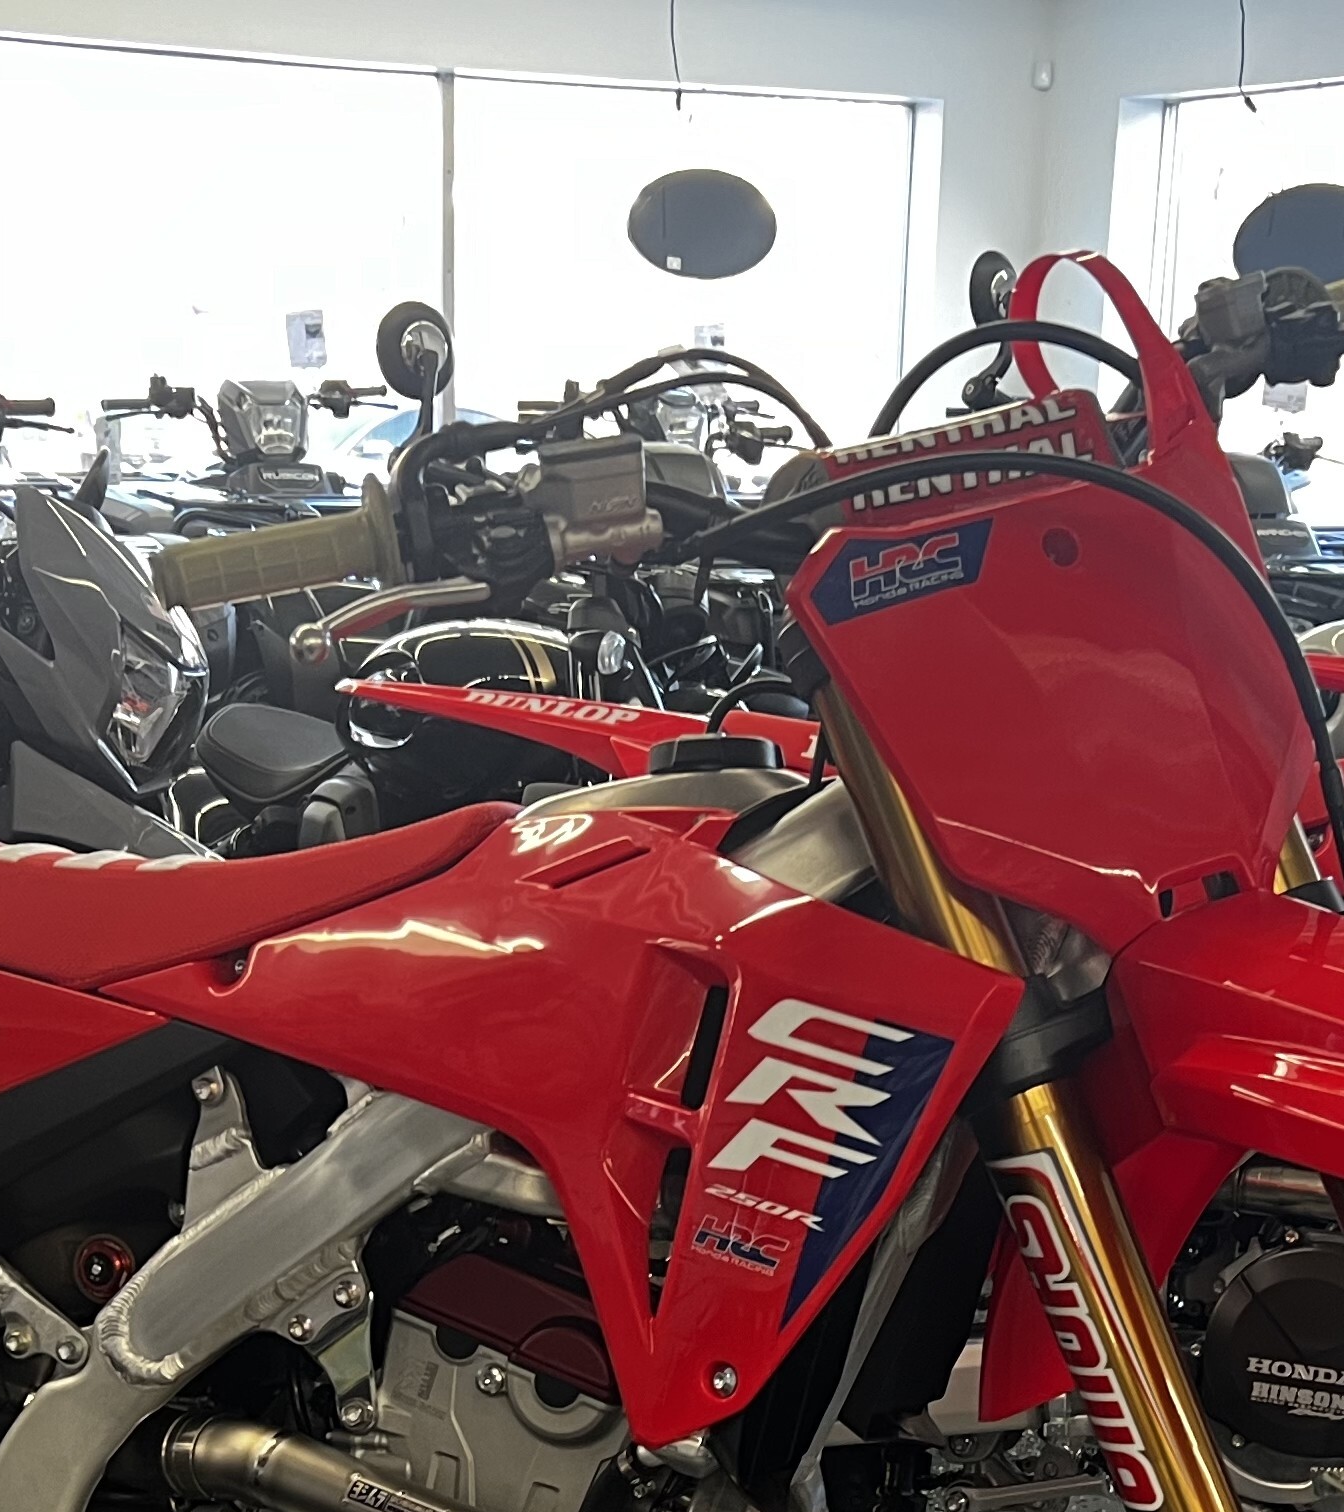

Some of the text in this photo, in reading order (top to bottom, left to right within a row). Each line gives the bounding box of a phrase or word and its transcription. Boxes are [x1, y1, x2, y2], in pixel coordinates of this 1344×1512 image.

[849, 532, 963, 602] HRC
[464, 690, 641, 726] DUNLOP
[706, 998, 917, 1180] CRF
[705, 1183, 826, 1233] 250R
[692, 1214, 791, 1272] HRC
